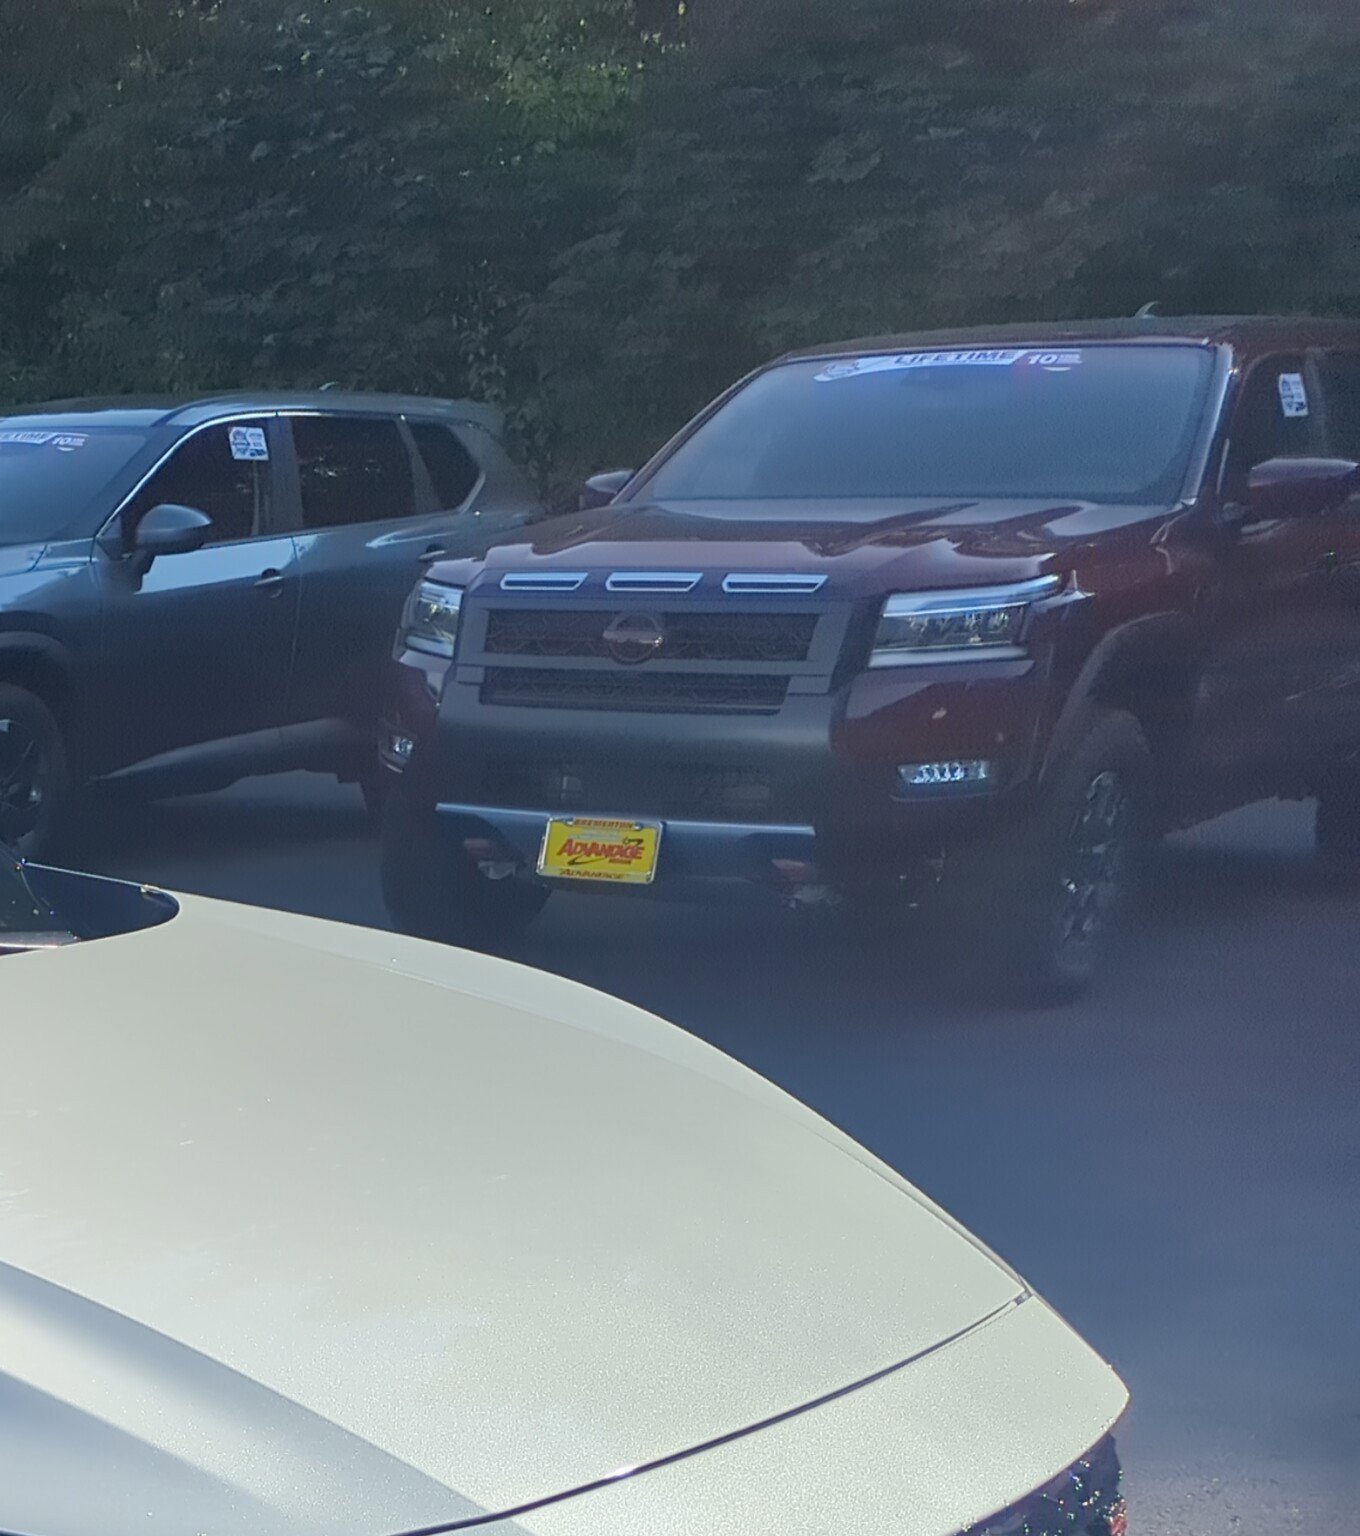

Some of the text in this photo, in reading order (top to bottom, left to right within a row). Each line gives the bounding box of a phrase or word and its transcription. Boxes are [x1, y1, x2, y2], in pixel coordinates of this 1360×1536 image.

[893, 350, 1016, 365] LIFETIME
[1028, 353, 1058, 365] 10
[557, 839, 645, 859] ADVANTAGE
